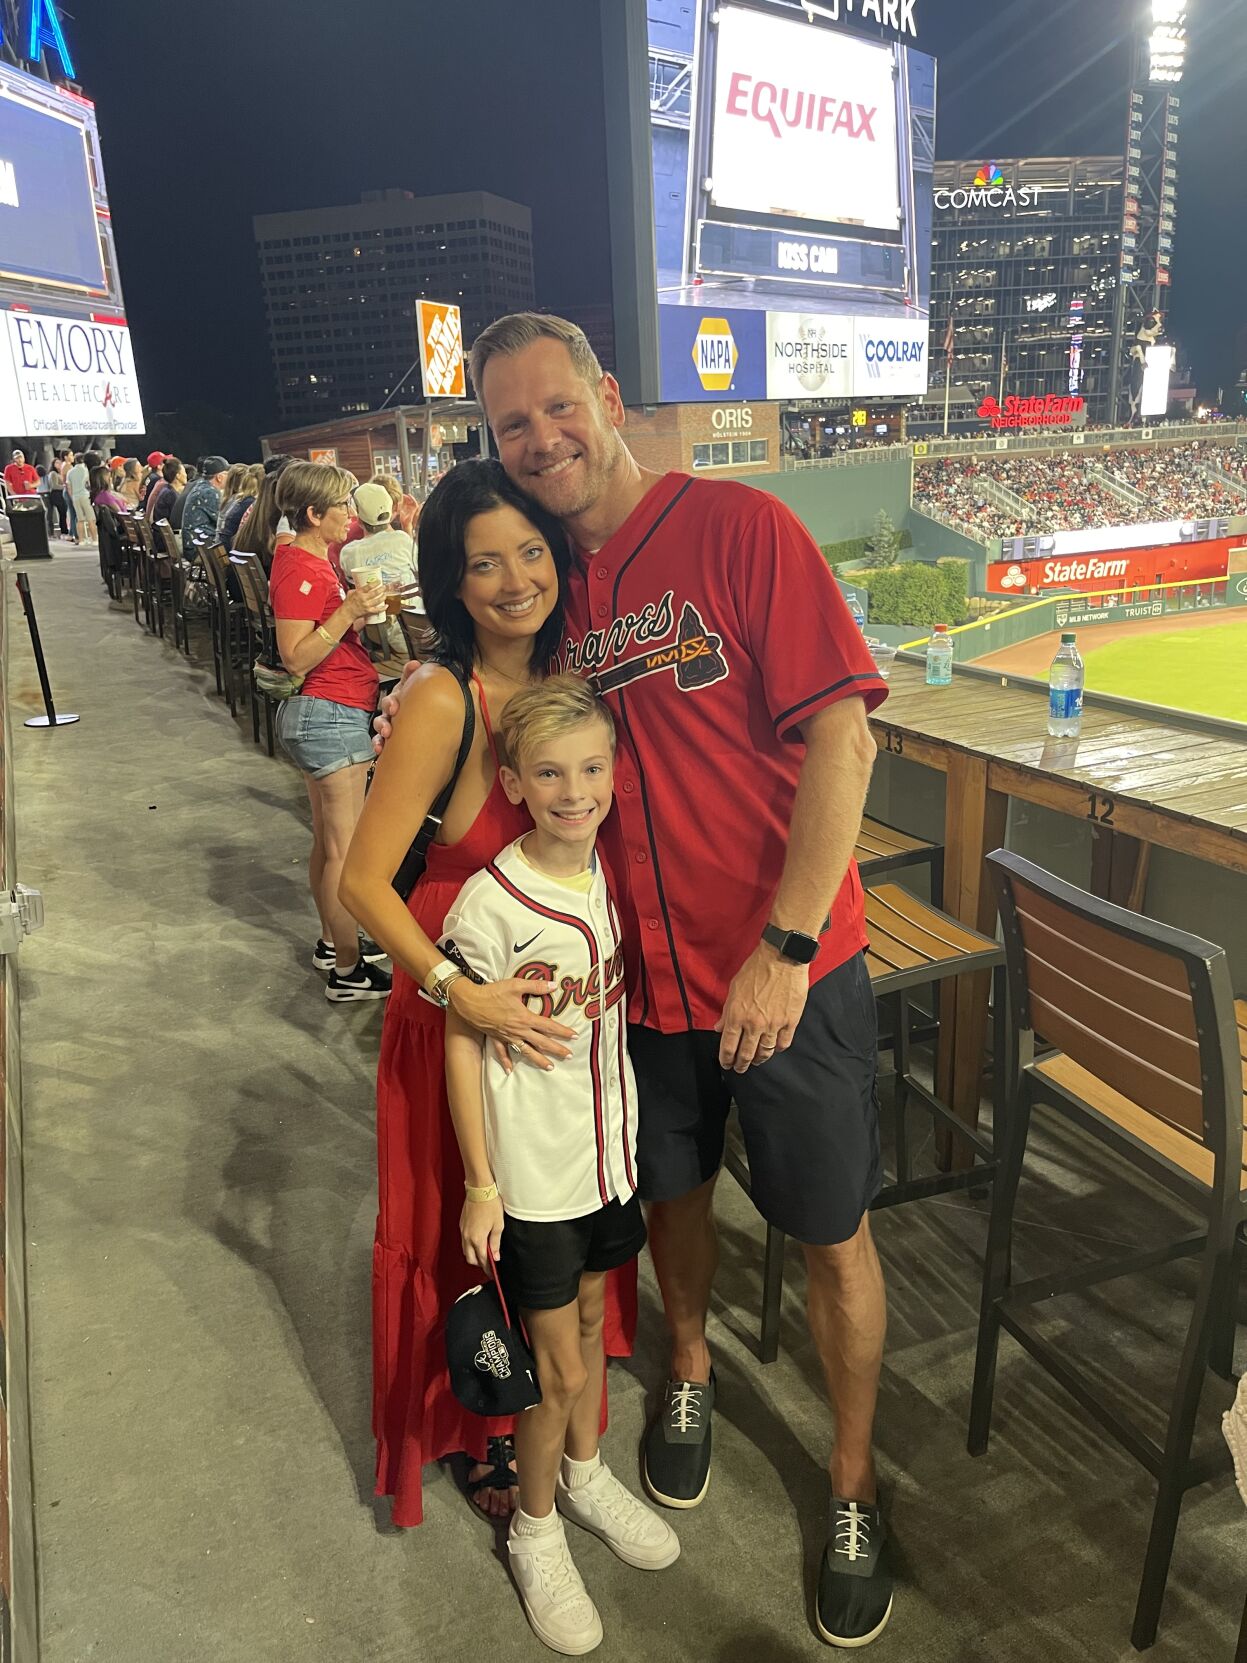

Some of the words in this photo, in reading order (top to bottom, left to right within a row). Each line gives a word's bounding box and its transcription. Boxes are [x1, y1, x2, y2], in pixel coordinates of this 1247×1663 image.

[725, 71, 878, 142] EQUIFAX
[934, 186, 1042, 210] COMCAST
[778, 241, 808, 272] KISS
[810, 245, 838, 274] CAM
[13, 317, 126, 375] EMORY
[700, 339, 732, 370] NAPA
[774, 342, 848, 359] NORTHSIDE
[865, 339, 924, 362] COOLRAY
[788, 363, 835, 374] HOSPITAL
[26, 381, 131, 408] HEALTHCARE
[59, 419, 78, 431] Team
[711, 407, 753, 430] ORIS
[991, 413, 1072, 428] NEIGHBORHOOD
[1068, 615, 1082, 623] MLB
[1082, 612, 1110, 622] NETWORK
[1125, 606, 1152, 617] TRUIST
[565, 590, 674, 675] raves
[884, 730, 904, 755] 13
[1087, 793, 1115, 826] 12
[484, 1331, 511, 1378] CHAMPIONS
